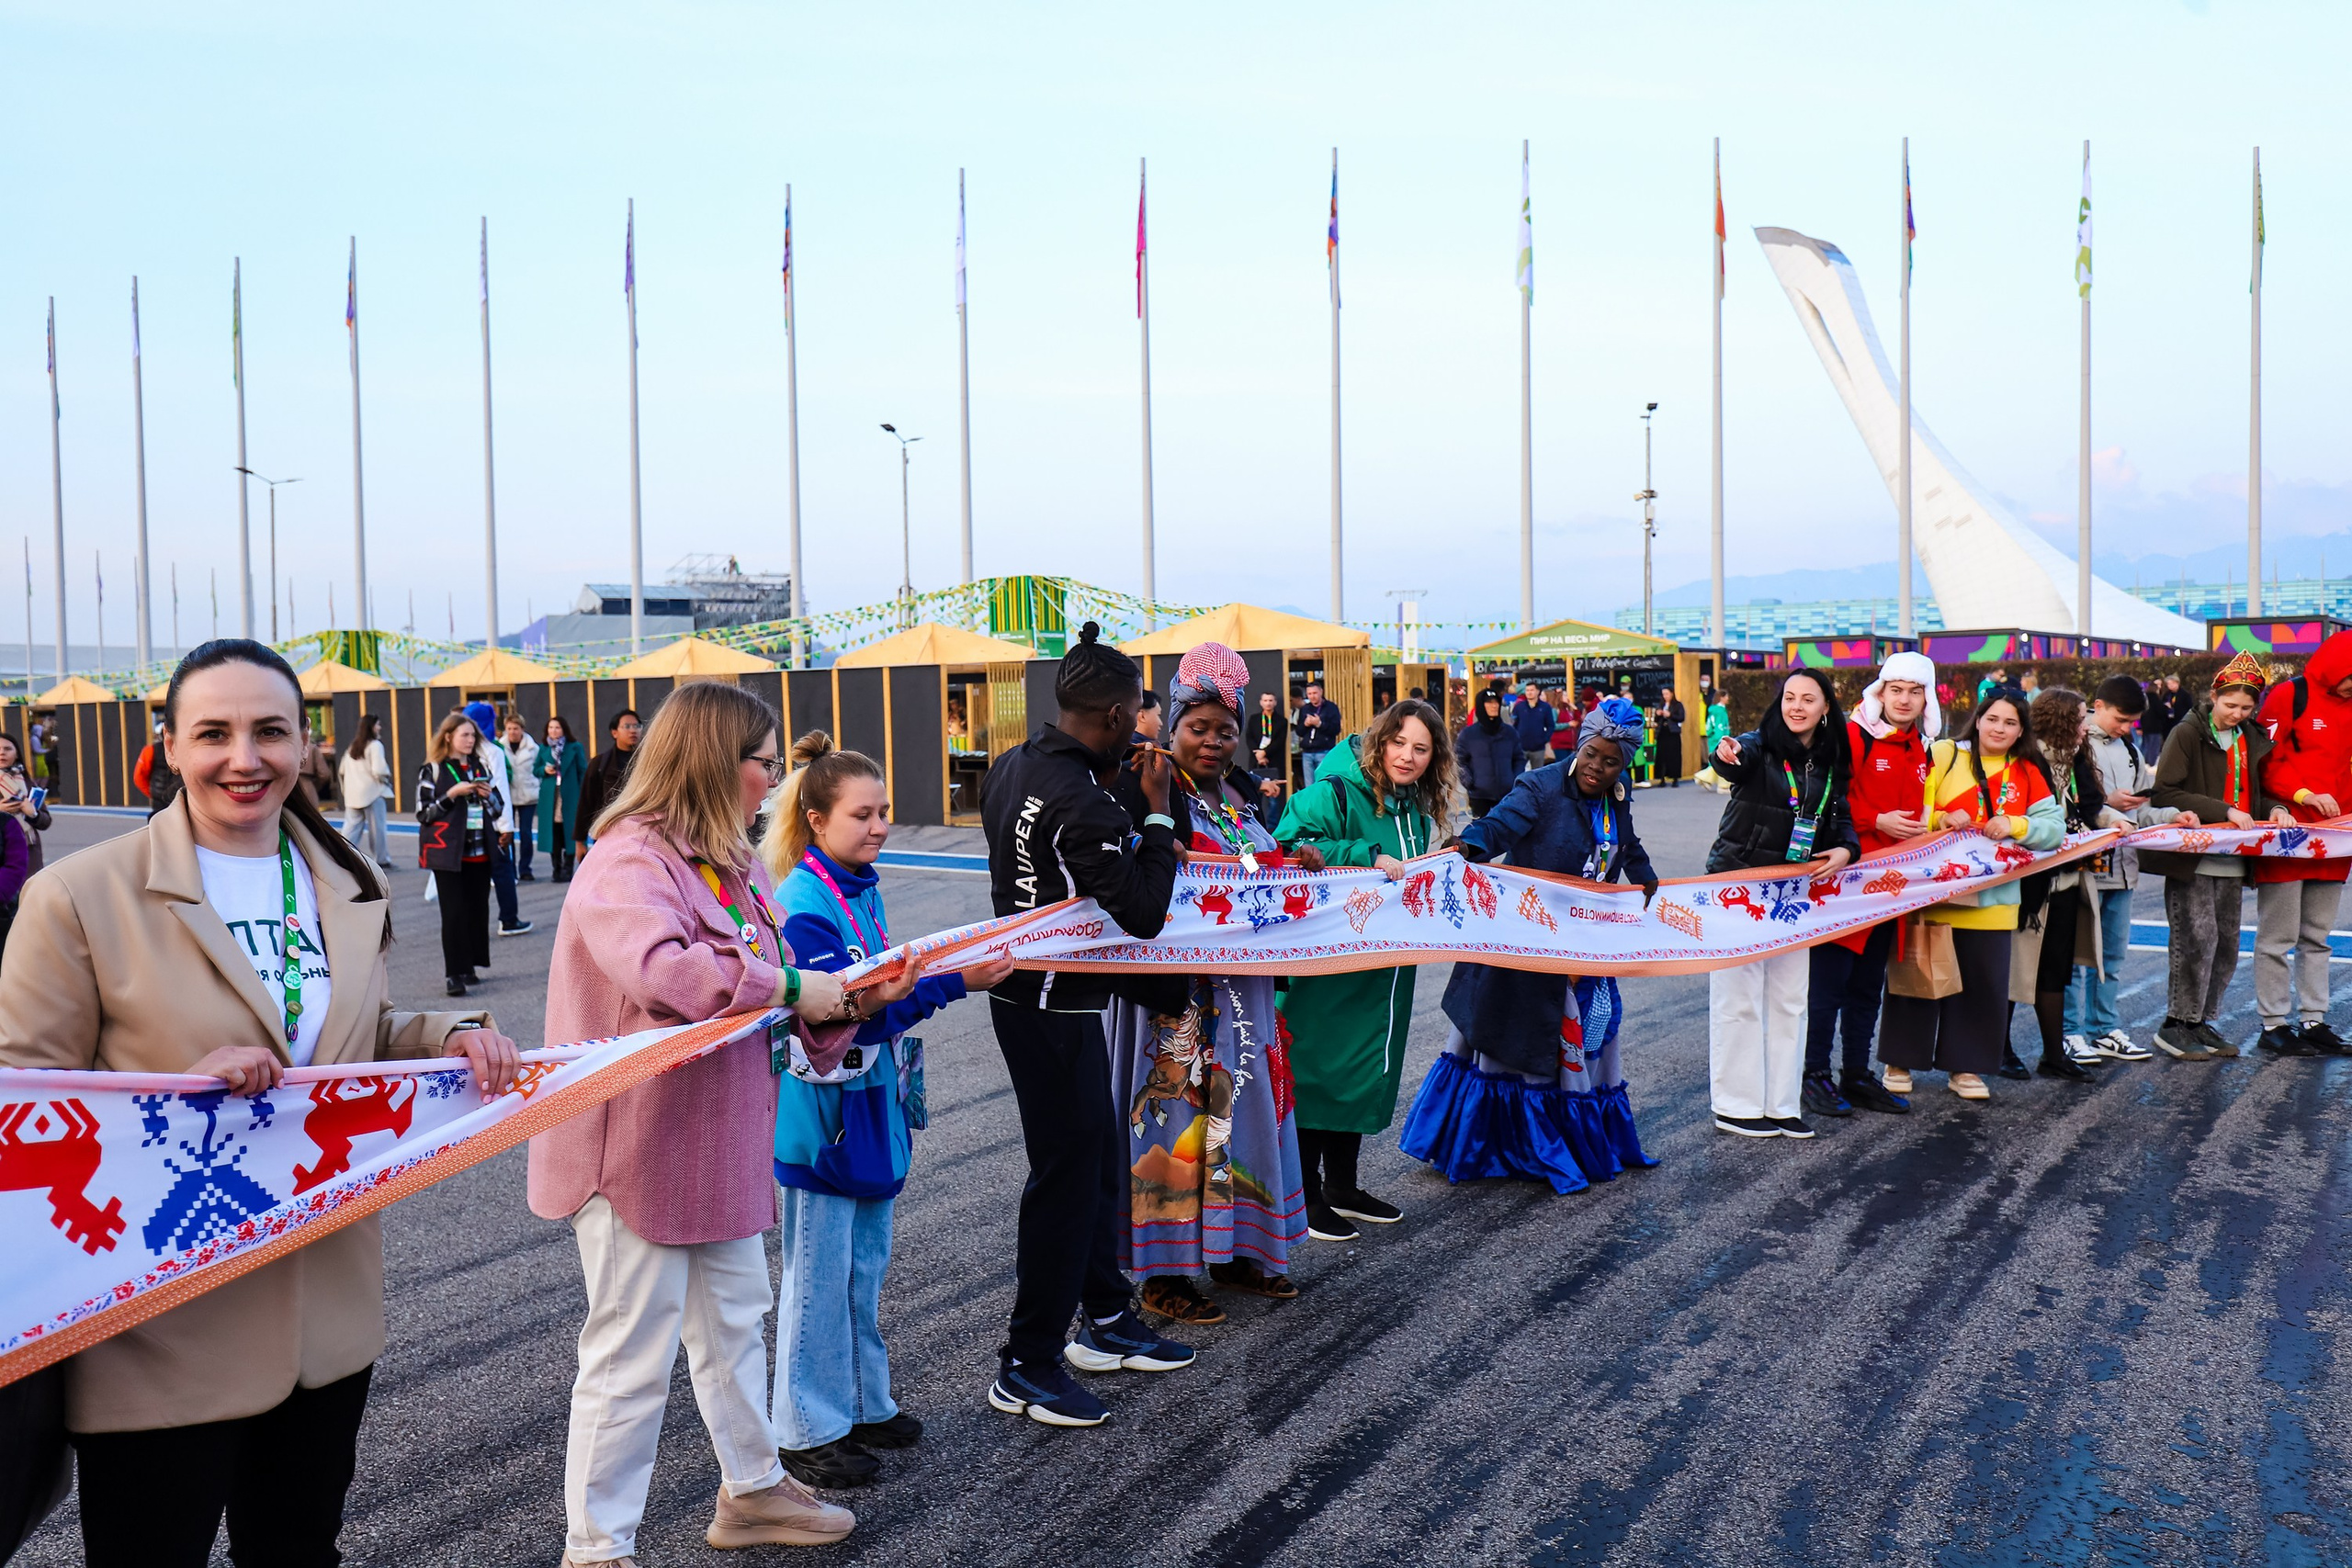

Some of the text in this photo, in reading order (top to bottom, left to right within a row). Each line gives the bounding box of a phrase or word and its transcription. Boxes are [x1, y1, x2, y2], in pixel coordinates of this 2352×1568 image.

[1530, 633, 1611, 646] ПИР НА ВЕСЬ МИР
[1014, 800, 1041, 908] LAUPEN
[808, 953, 835, 964] Pioneers
[1240, 1051, 1256, 1066] la
